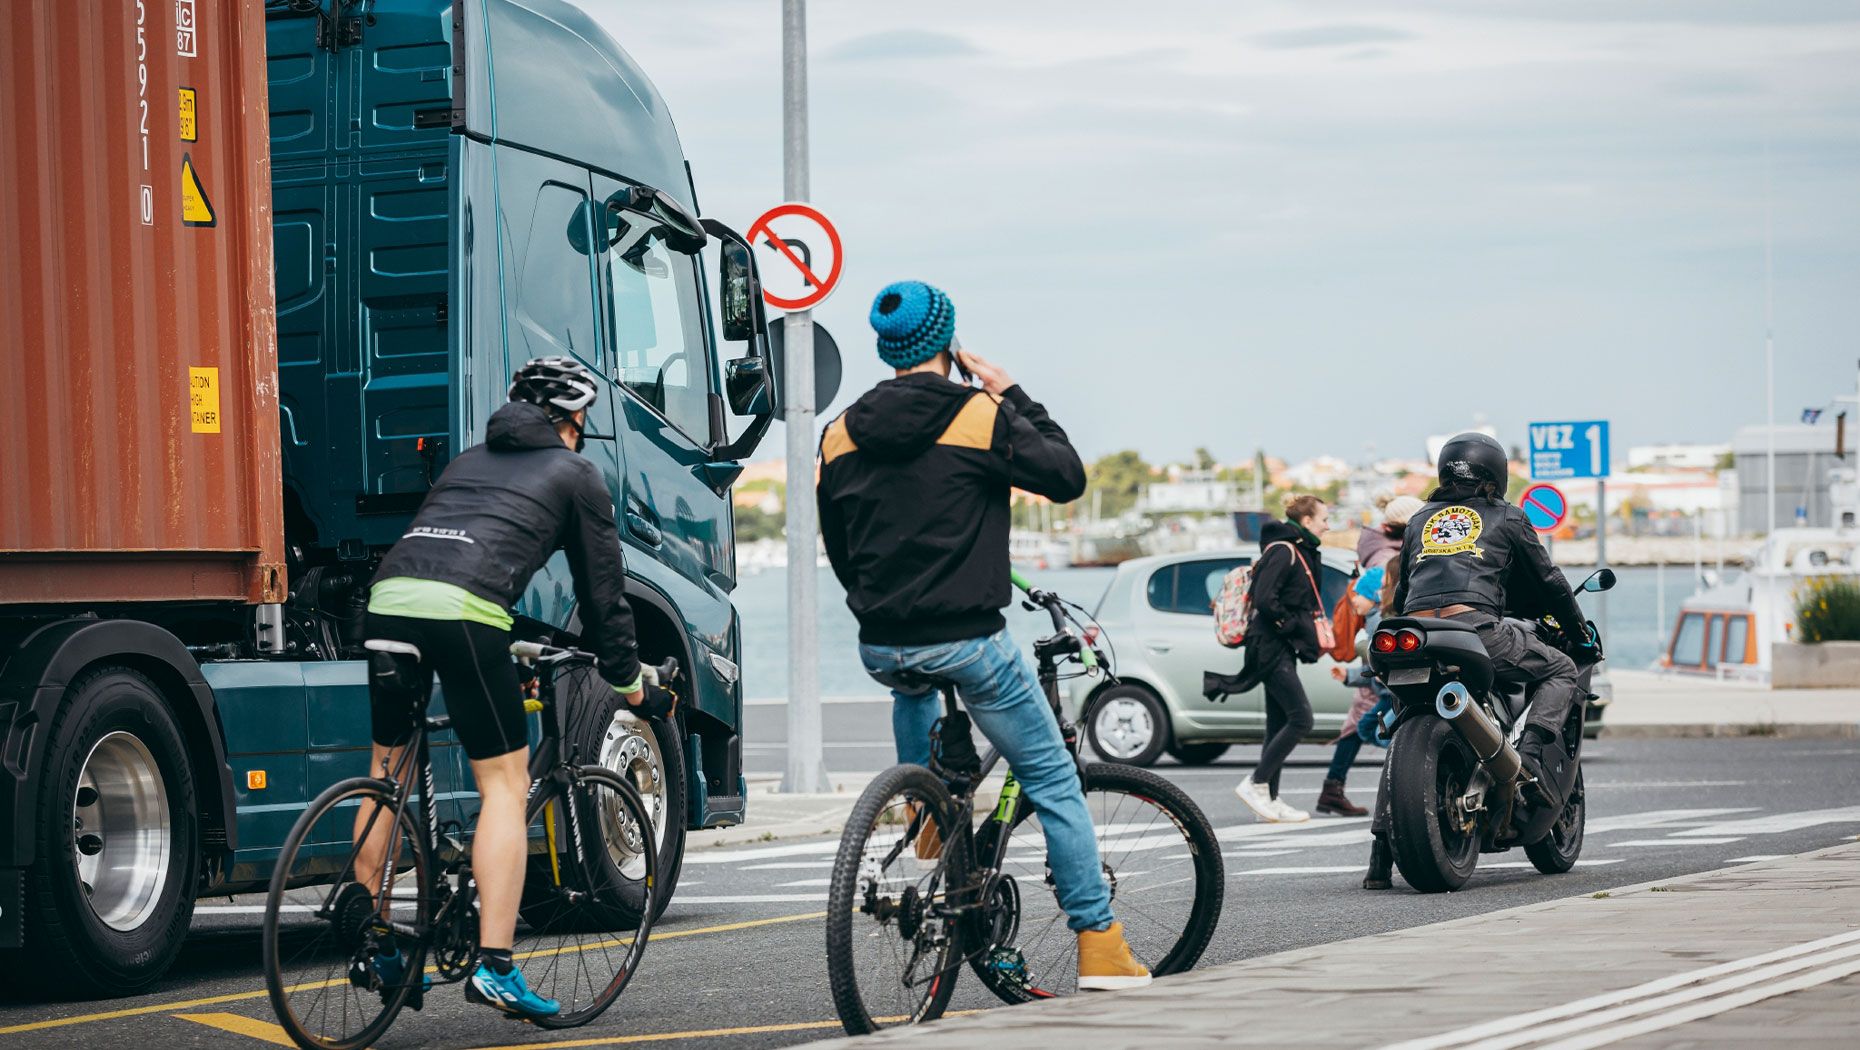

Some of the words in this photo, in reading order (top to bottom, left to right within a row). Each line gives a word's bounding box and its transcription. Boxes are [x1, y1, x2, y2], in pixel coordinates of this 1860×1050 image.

[177, 32, 190, 51] 87
[1531, 424, 1575, 450] VEZ
[1584, 424, 1602, 476] 1
[1423, 518, 1438, 535] VUK
